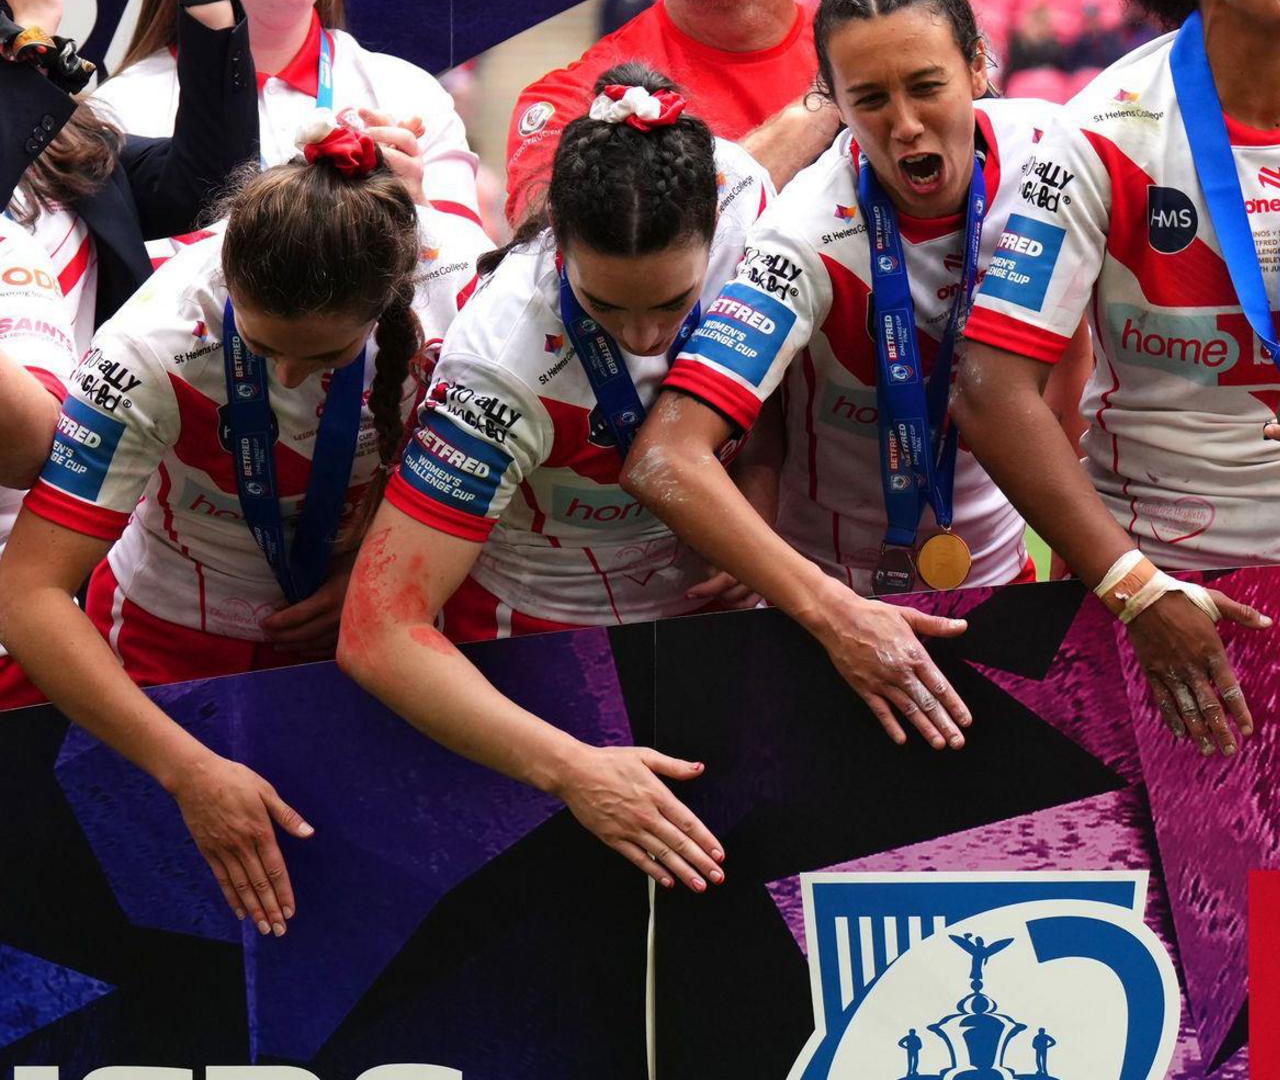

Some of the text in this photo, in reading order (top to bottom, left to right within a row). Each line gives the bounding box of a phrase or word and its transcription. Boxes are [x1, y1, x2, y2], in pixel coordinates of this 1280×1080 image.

[1151, 207, 1192, 229] HMS
[822, 234, 833, 244] St
[833, 227, 858, 240] Helens
[1008, 273, 1030, 285] CUP
[885, 315, 899, 359] BETFRED
[1122, 317, 1227, 366] home
[174, 353, 184, 364] St
[185, 345, 211, 362] Helens
[596, 335, 619, 375] BETFRED
[734, 342, 758, 358] CUP
[539, 372, 549, 385] St
[417, 427, 491, 479] BETFRED
[65, 461, 88, 474] CUP
[405, 454, 476, 502] CHALLENGE CUP
[418, 455, 463, 487] WOMEN'S
